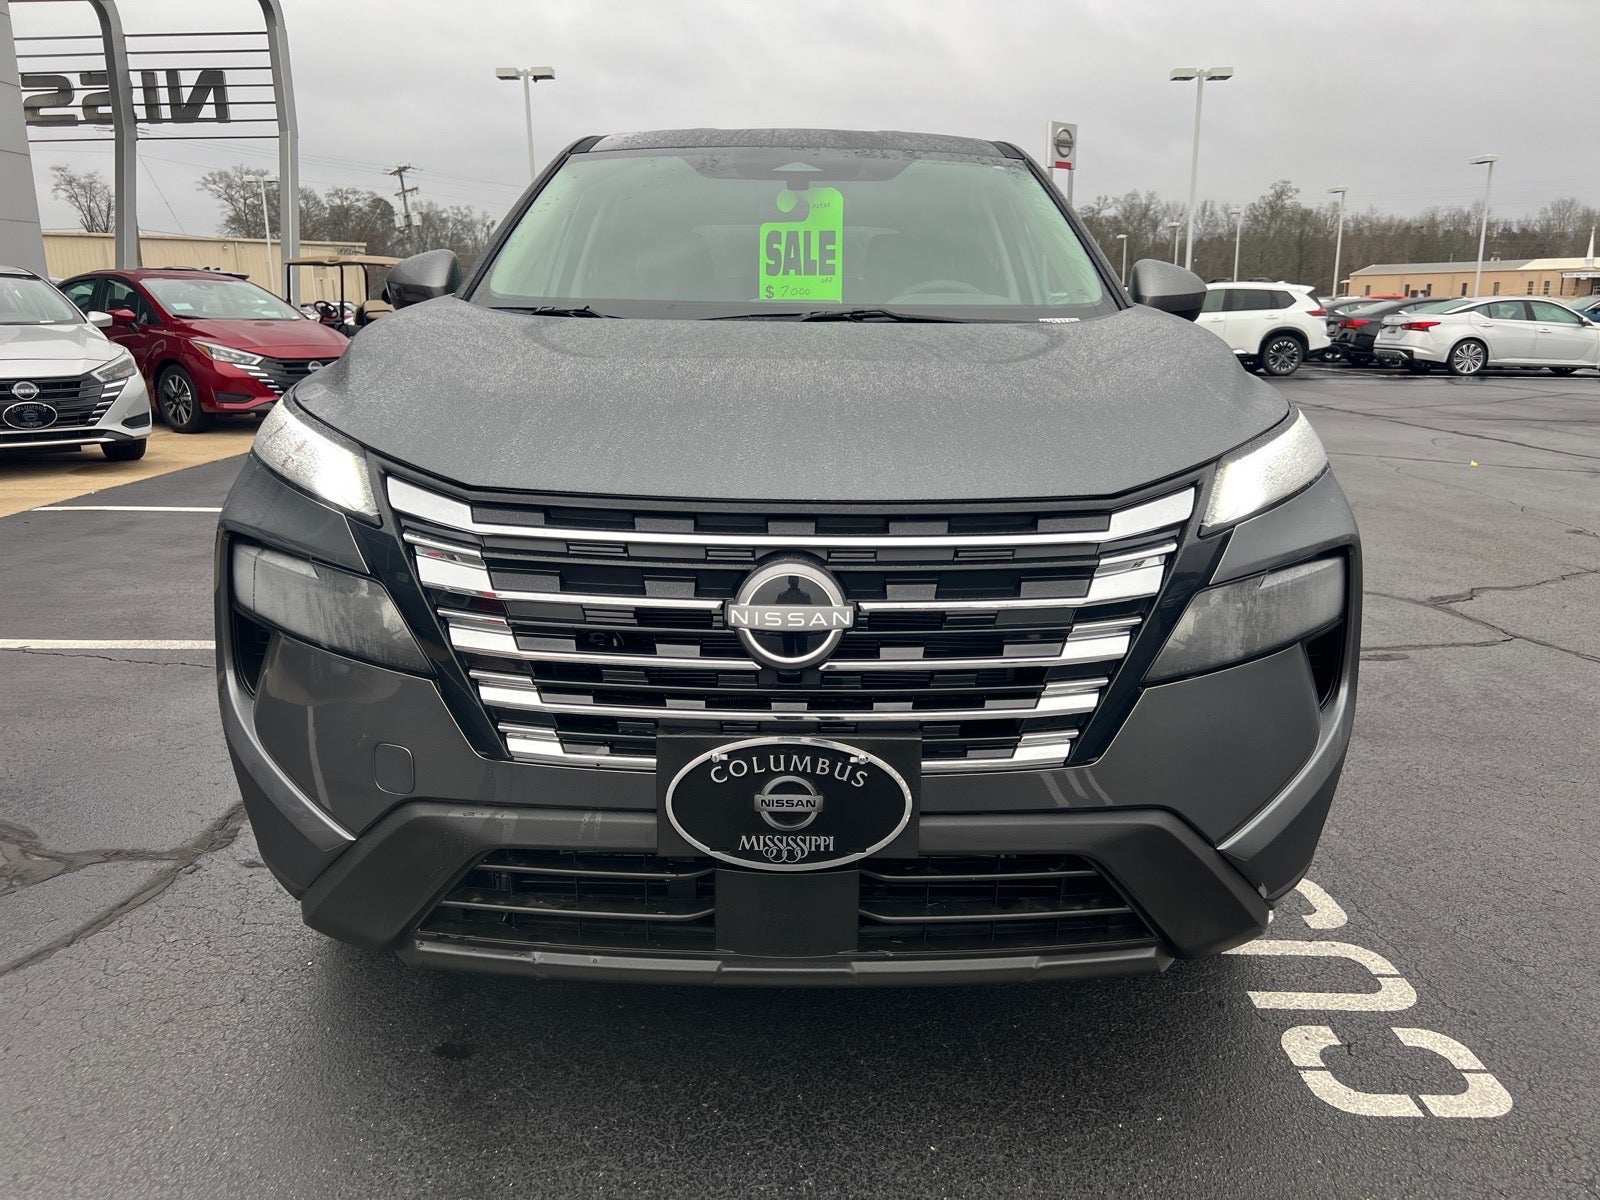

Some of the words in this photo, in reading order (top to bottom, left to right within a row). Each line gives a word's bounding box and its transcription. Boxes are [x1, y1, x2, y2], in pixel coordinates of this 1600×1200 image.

[765, 230, 836, 277] SALE
[780, 285, 811, 298] 7000
[731, 609, 850, 627] NISSAN
[710, 754, 868, 788] COLUMBUS
[760, 798, 817, 808] NISSAN
[738, 835, 834, 862] MISSISSIPPI
